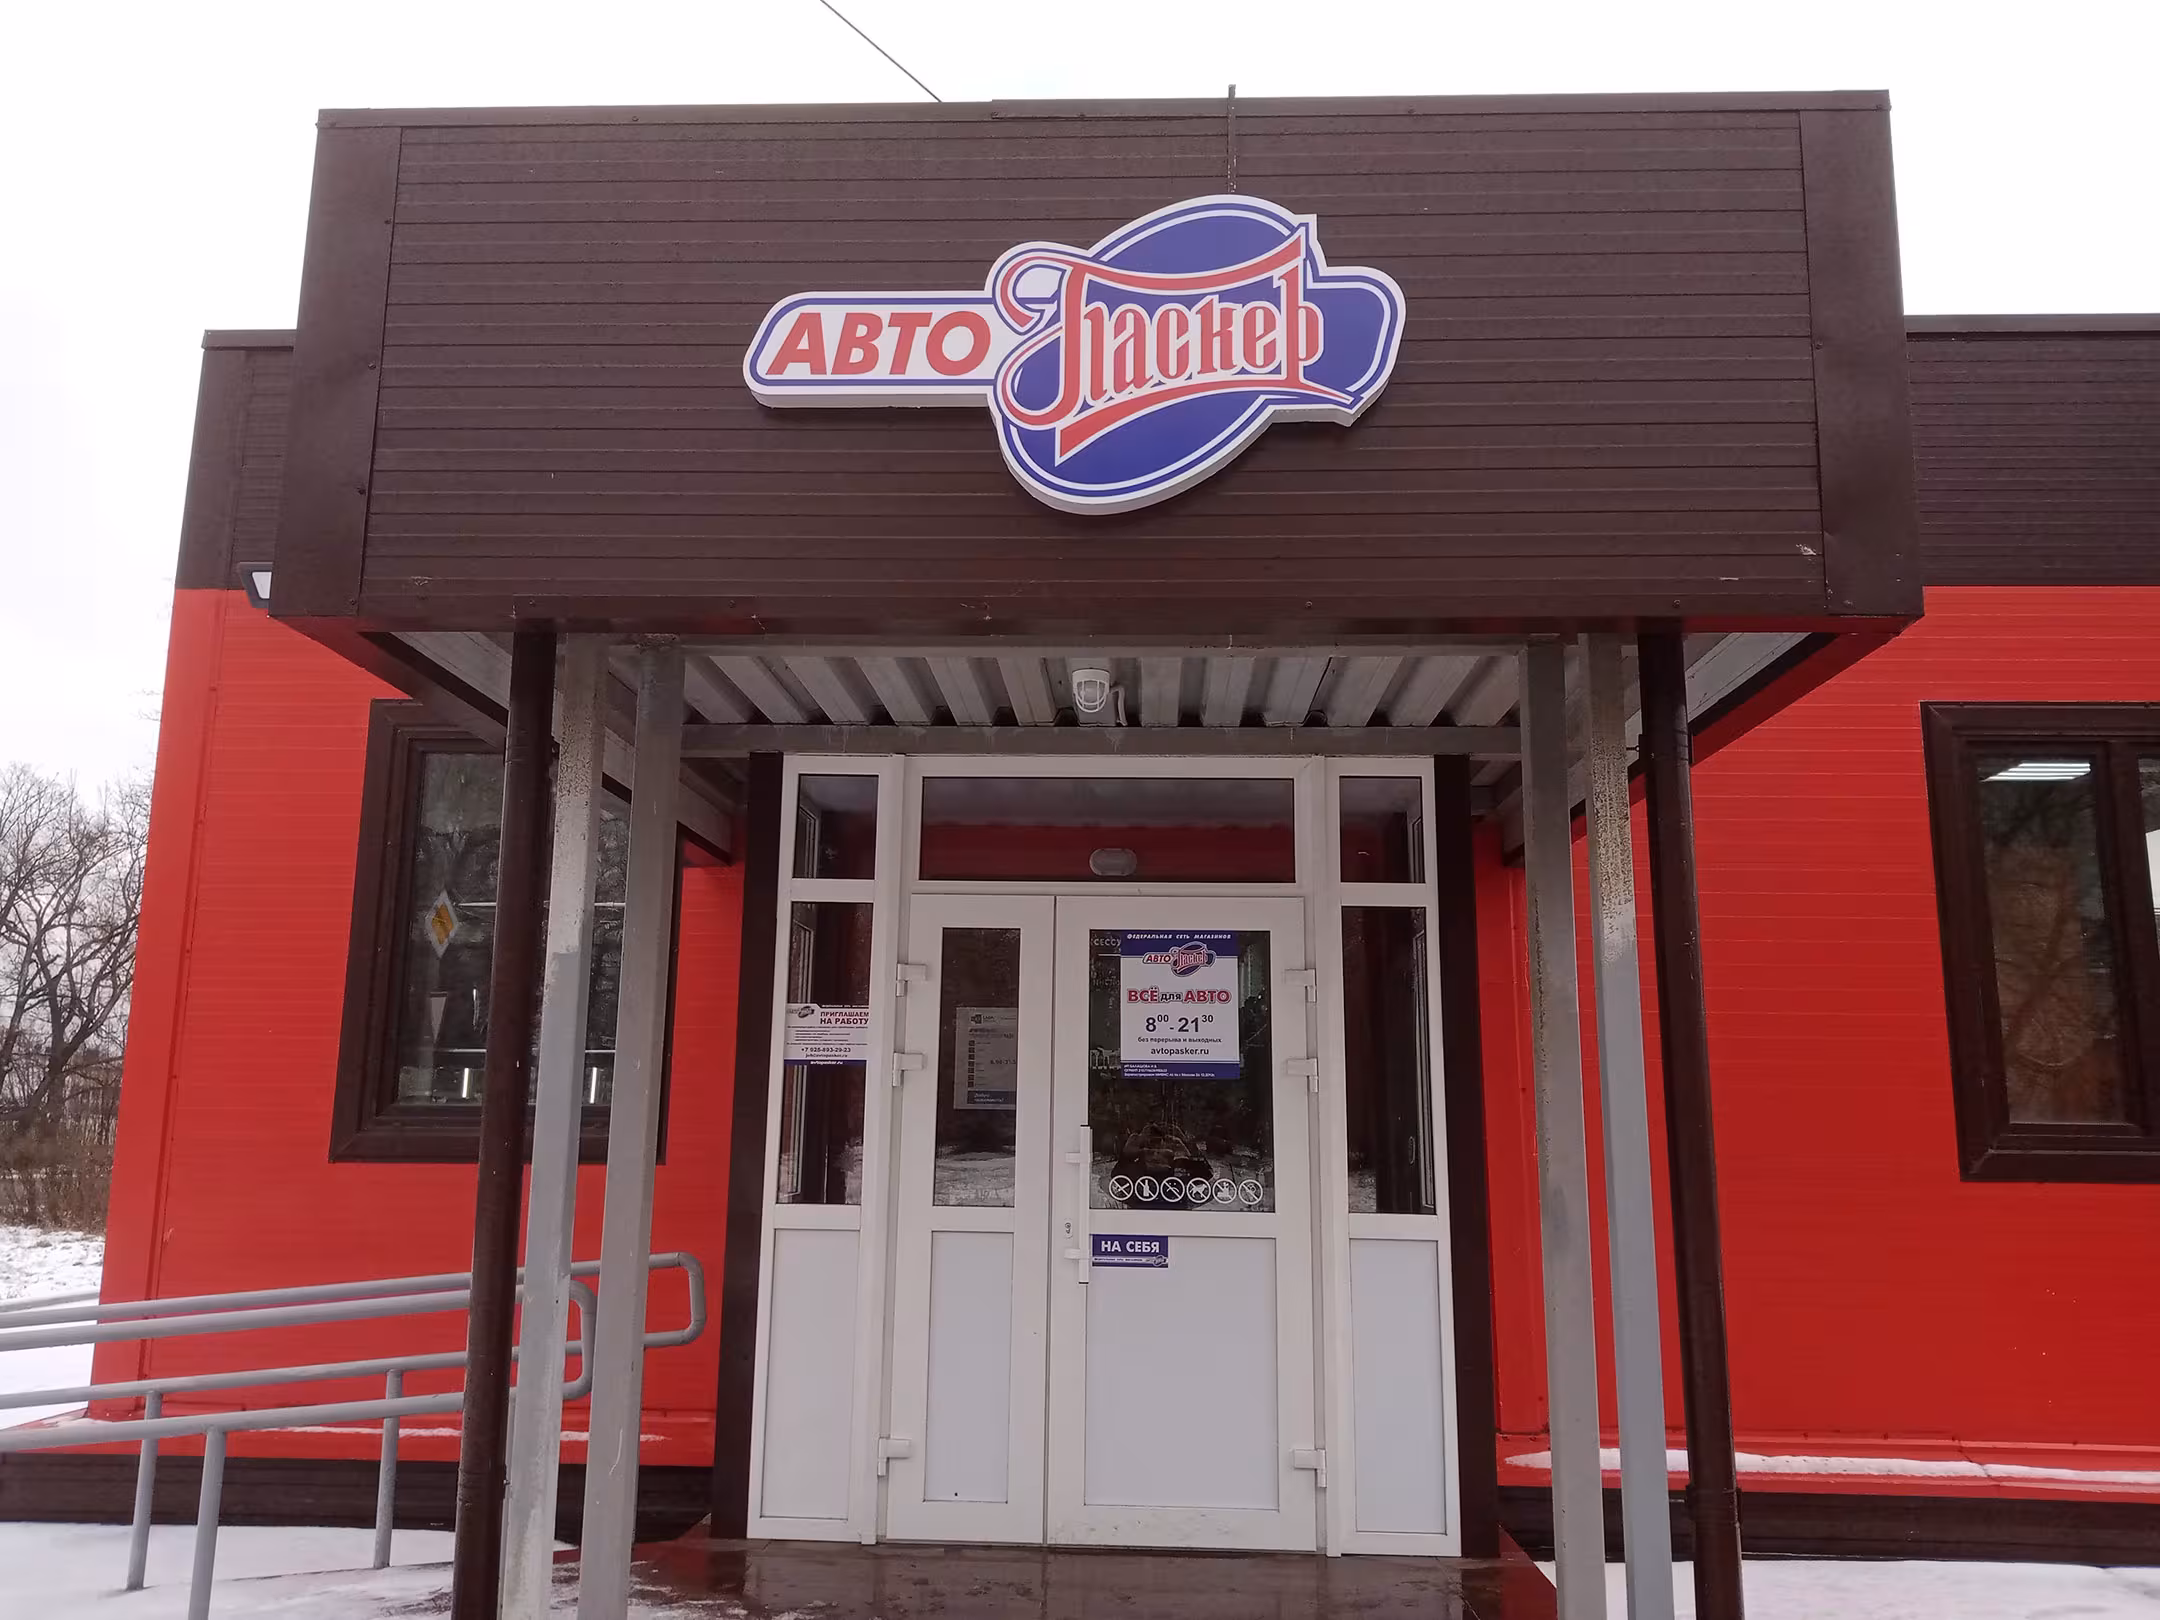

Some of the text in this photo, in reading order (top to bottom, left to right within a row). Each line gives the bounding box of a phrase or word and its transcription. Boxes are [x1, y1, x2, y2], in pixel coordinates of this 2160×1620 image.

[767, 228, 1346, 457] АВТО Паскер
[1146, 954, 1172, 963] АВТО
[1127, 986, 1231, 1003] ВСЁ для АВТО
[1150, 1047, 1210, 1056] avtopasker.ru
[1101, 1240, 1160, 1253] НА СЕБЯ
